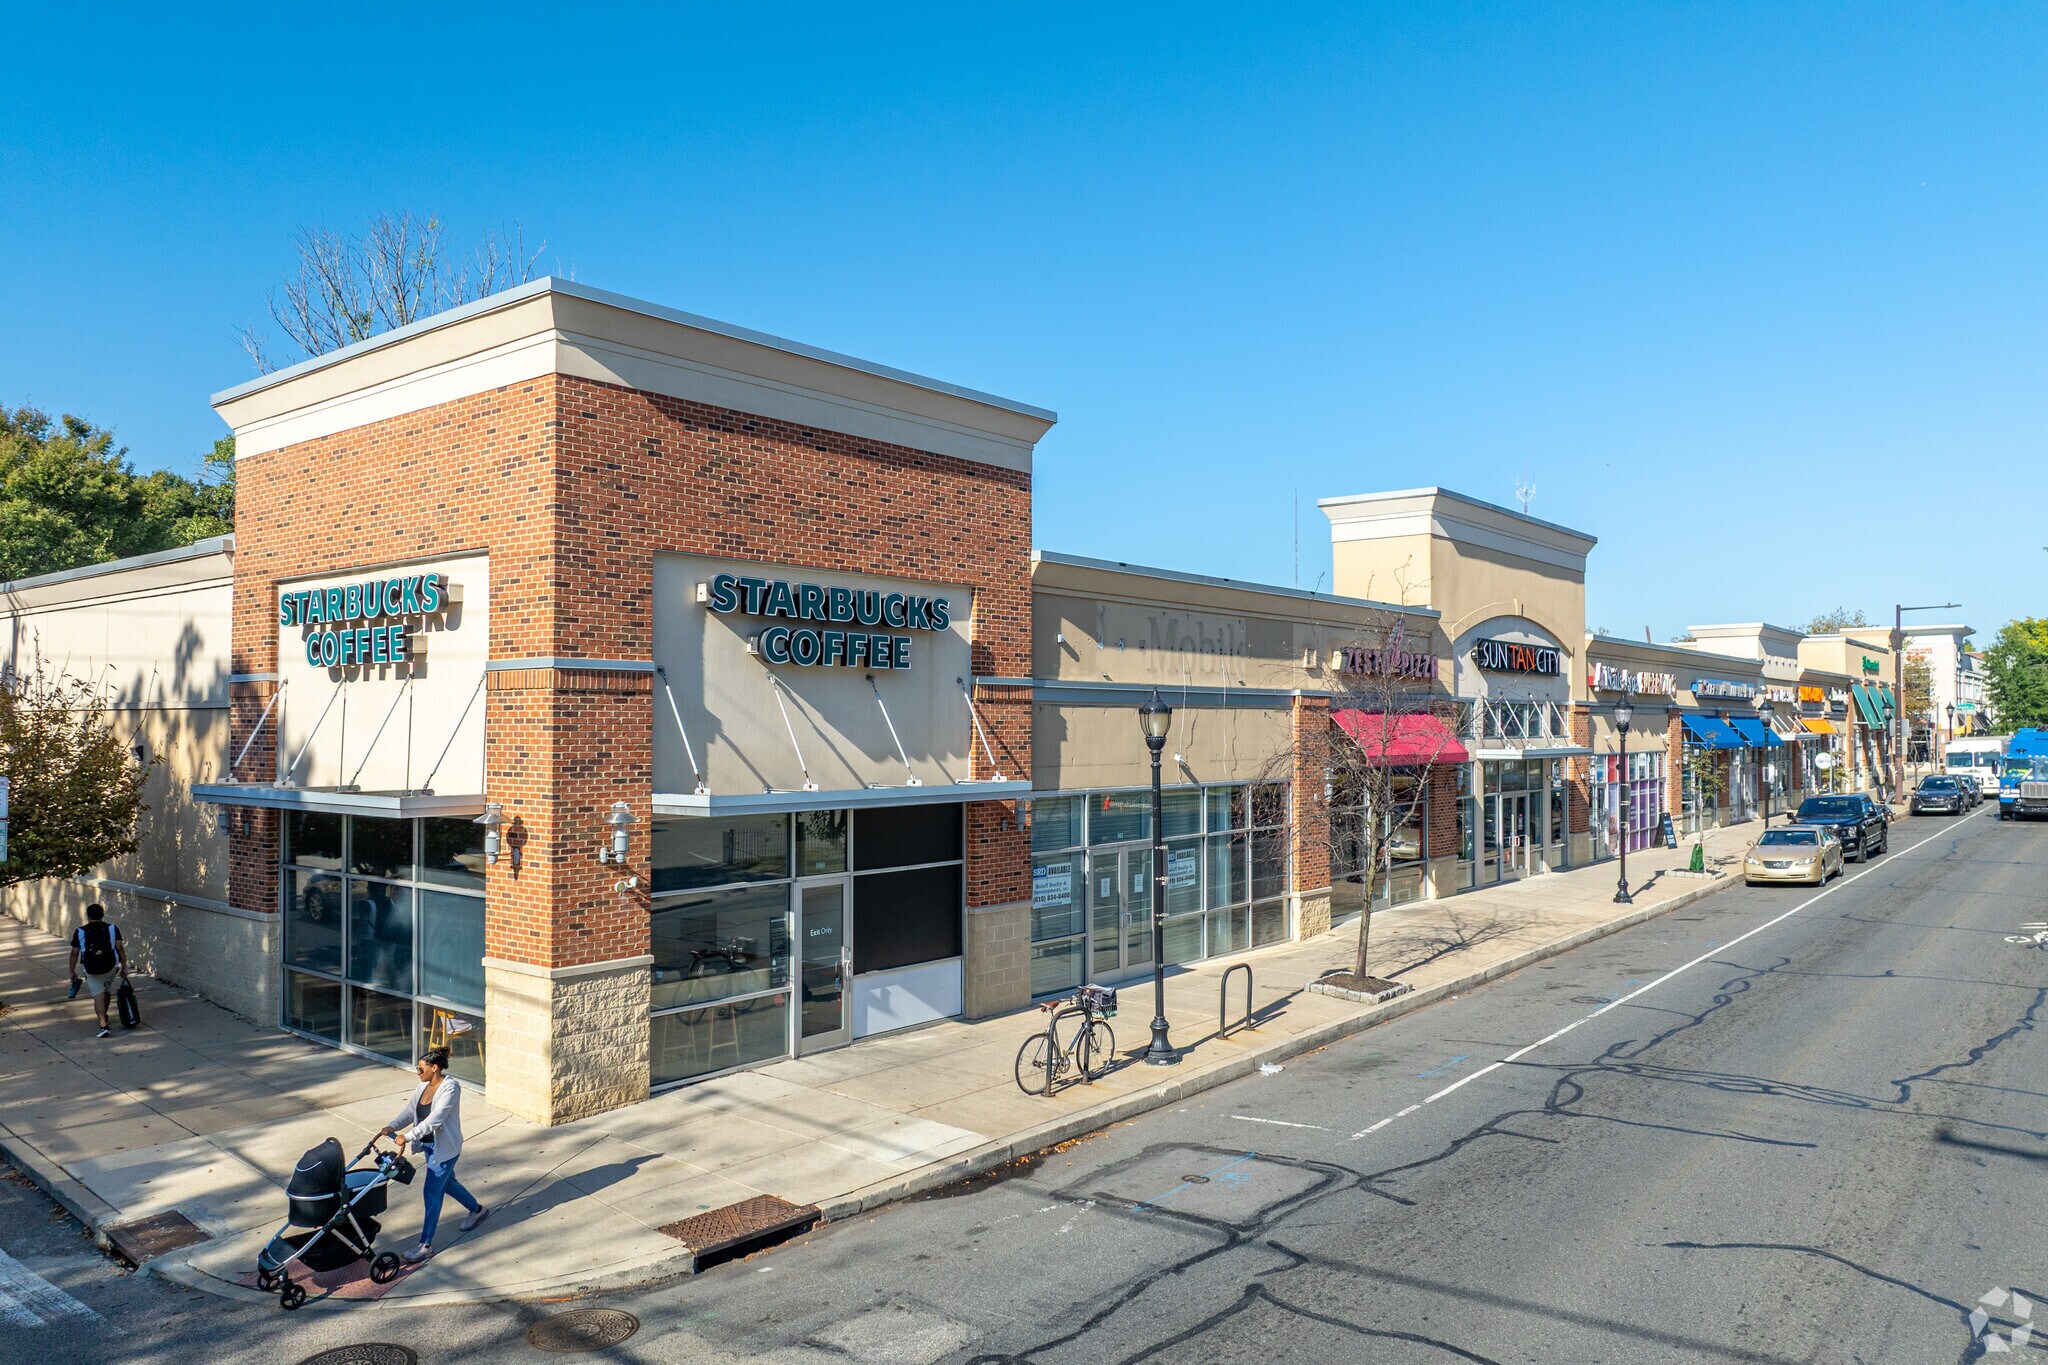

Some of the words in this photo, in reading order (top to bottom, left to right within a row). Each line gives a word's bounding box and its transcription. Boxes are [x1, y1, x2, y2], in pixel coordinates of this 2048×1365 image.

[280, 572, 448, 627] STARBUCKS
[708, 573, 951, 631] STARBUCKS
[306, 624, 406, 668] COFFEE
[760, 626, 912, 669] COFFEE
[1400, 651, 1439, 678] PIZZA
[1481, 641, 1508, 669] SUN
[1509, 644, 1535, 671] TAN
[1536, 648, 1560, 674] CITY
[1033, 867, 1047, 877] SRD
[1048, 864, 1071, 875] AVAILABLE
[810, 929, 820, 938] Exit
[820, 926, 833, 936] Only
